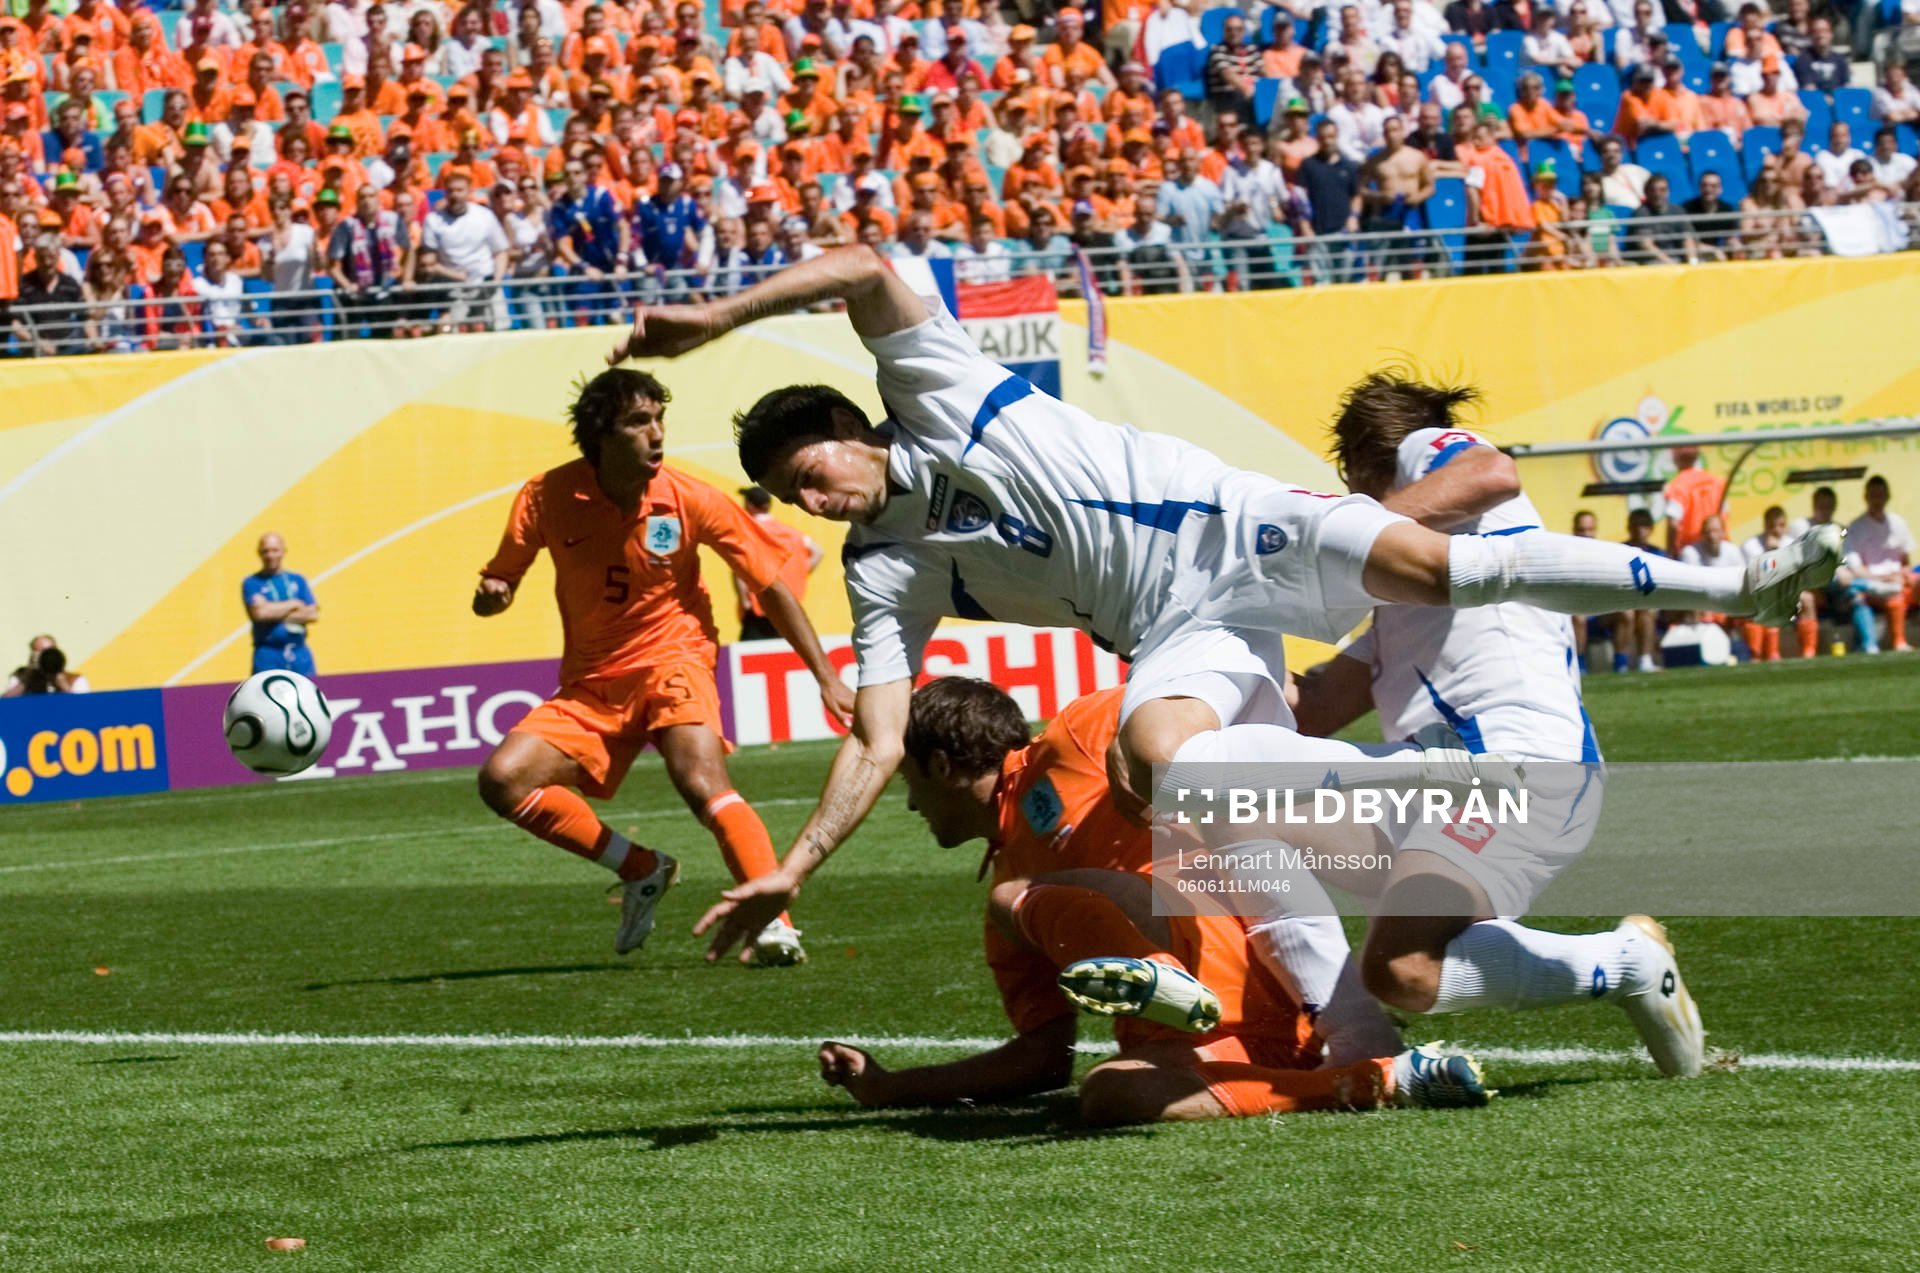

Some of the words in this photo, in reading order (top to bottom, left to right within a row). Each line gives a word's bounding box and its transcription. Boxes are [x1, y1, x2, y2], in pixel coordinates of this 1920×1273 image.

[964, 320, 1057, 357] AIJK
[1715, 401, 1751, 417] FIFA
[1756, 397, 1810, 414] WORLD
[1815, 396, 1843, 411] CUP
[999, 511, 1053, 558] 8
[604, 565, 630, 604] 5
[741, 630, 1128, 742] TSHI
[277, 685, 562, 781] AHO
[0, 724, 156, 797] .com
